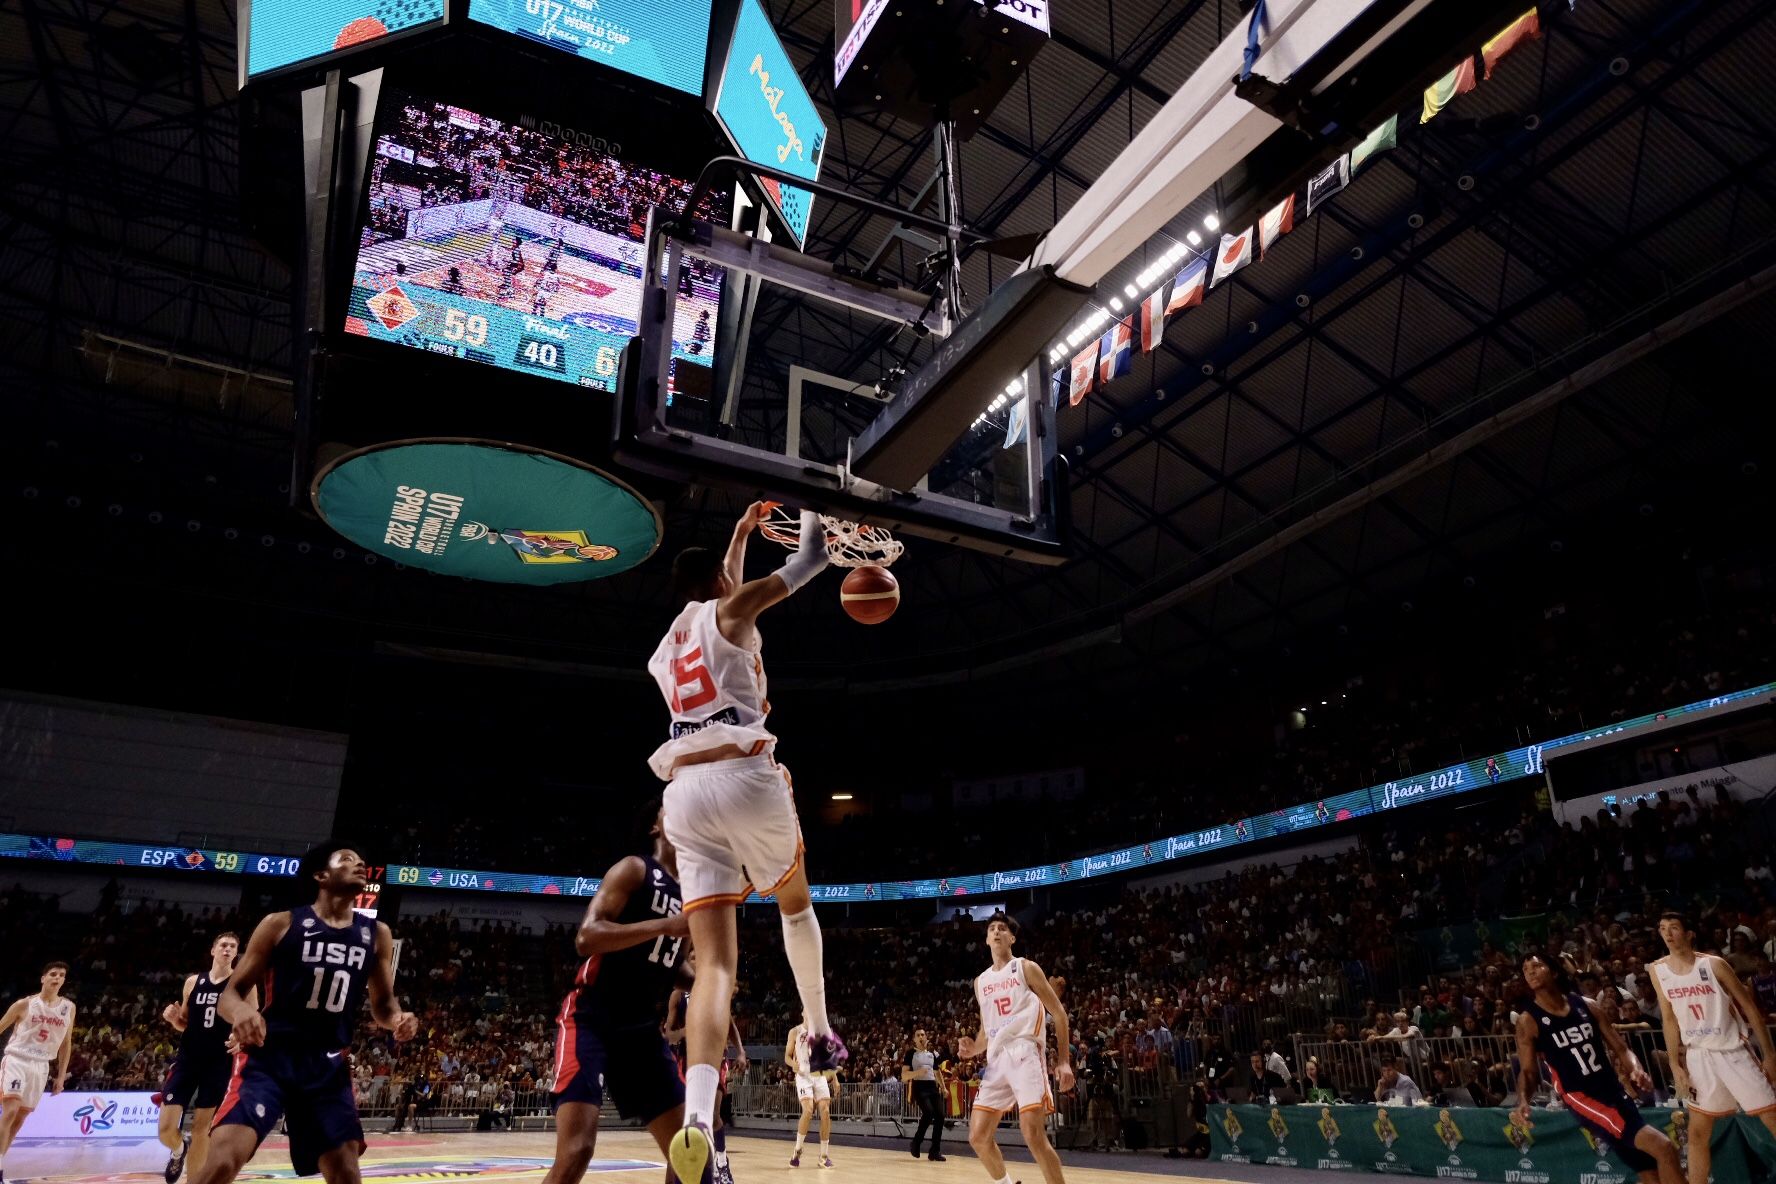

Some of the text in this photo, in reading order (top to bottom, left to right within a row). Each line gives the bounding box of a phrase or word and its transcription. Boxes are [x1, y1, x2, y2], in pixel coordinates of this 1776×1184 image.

[564, 15, 604, 37] WORLD
[540, 120, 621, 156] MONDO
[443, 308, 489, 347] 59
[383, 485, 428, 549] SPAIN 2022
[426, 492, 465, 520] U17
[418, 516, 443, 541] WORLD
[1382, 769, 1465, 809] Spain 2022
[1165, 829, 1222, 859] Spain 2022
[140, 850, 175, 866] ESP
[214, 852, 300, 875] 59 6:10
[1081, 851, 1132, 878] Spain 2022
[363, 883, 380, 893] :10
[398, 866, 479, 889] 69 USA
[571, 877, 600, 896] Spai
[990, 869, 1047, 891] Spain 2022
[355, 893, 377, 909] 17
[651, 889, 682, 918] US
[824, 887, 850, 898] 2022
[301, 941, 367, 970] USA
[196, 992, 218, 1005] US
[305, 967, 351, 1013] 10
[1667, 983, 1717, 999] ESPAÑA
[204, 1006, 215, 1028] 9
[994, 997, 1012, 1017] 12
[1688, 1004, 1705, 1020] 11
[38, 1029, 49, 1043] 5
[1551, 1022, 1594, 1049] USA
[1570, 1043, 1603, 1077] 12
[1318, 1159, 1330, 1169] U17
[1436, 1166, 1451, 1177] U17
[1505, 1170, 1520, 1183] U17
[1580, 1173, 1597, 1184] U17
